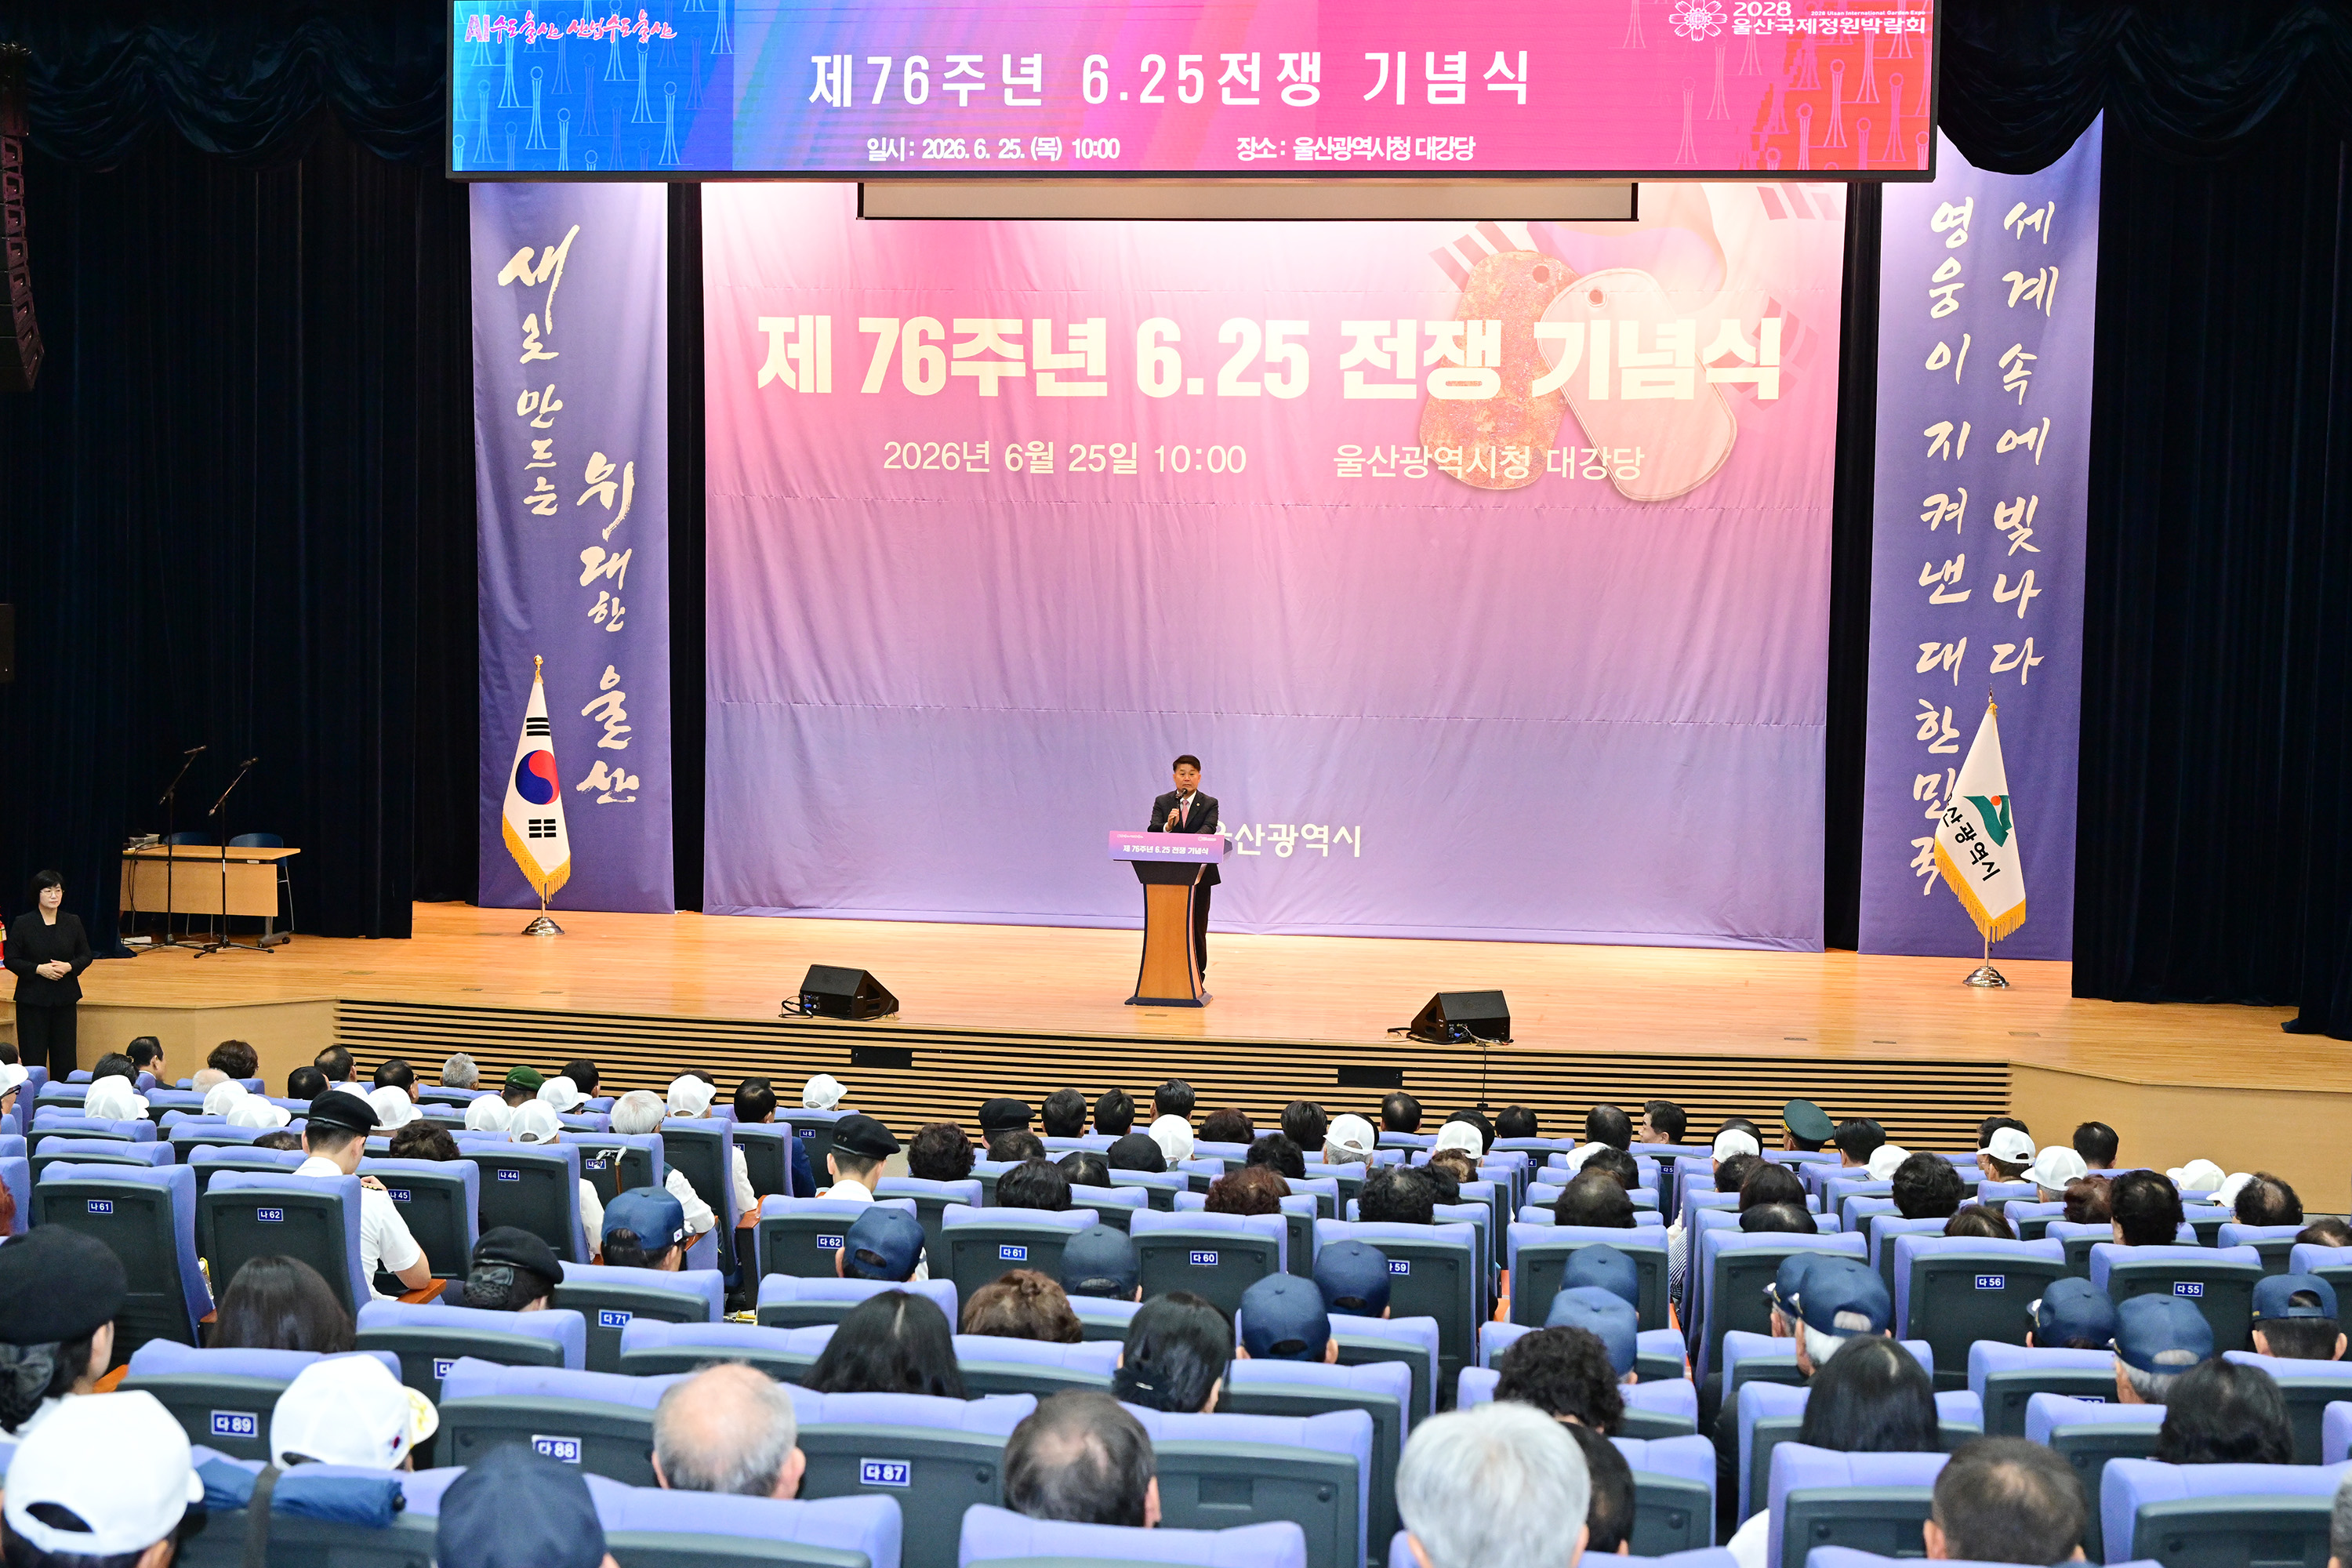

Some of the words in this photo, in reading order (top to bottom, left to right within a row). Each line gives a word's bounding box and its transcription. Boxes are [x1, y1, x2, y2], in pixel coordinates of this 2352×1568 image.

[1732, 1, 1791, 16] 2028
[1732, 16, 1926, 35] 울산국제정원박람회
[1363, 51, 1527, 105] 기념식
[1030, 136, 1063, 162] (목)
[1072, 137, 1120, 159] 10:00
[1293, 136, 1410, 162] 울산광역시청
[1415, 136, 1476, 162] 대강당
[757, 314, 832, 394] 제
[858, 315, 1108, 397] 76주년
[1137, 317, 1309, 399] 6.25
[1340, 318, 1502, 400] 전쟁
[1532, 317, 1781, 401] 기념식
[884, 441, 990, 472] 2026년
[1004, 441, 1054, 474] 6월
[1069, 441, 1138, 474] 25일
[1154, 445, 1247, 474] 10:00
[1333, 444, 1531, 480] 울산광역시청
[1546, 445, 1646, 481] 대강당
[1943, 793, 2001, 882] 산광역시
[1172, 846, 1186, 855] 전쟁
[1395, 1263, 1406, 1272] 59
[1989, 1278, 2001, 1287] 56
[604, 1315, 612, 1323] 다
[615, 1315, 626, 1324] 71
[216, 1417, 229, 1431] 다
[232, 1417, 251, 1432] 89
[538, 1442, 552, 1456] 다
[554, 1443, 575, 1457] 88
[866, 1465, 880, 1480] 다
[884, 1465, 904, 1480] 87
